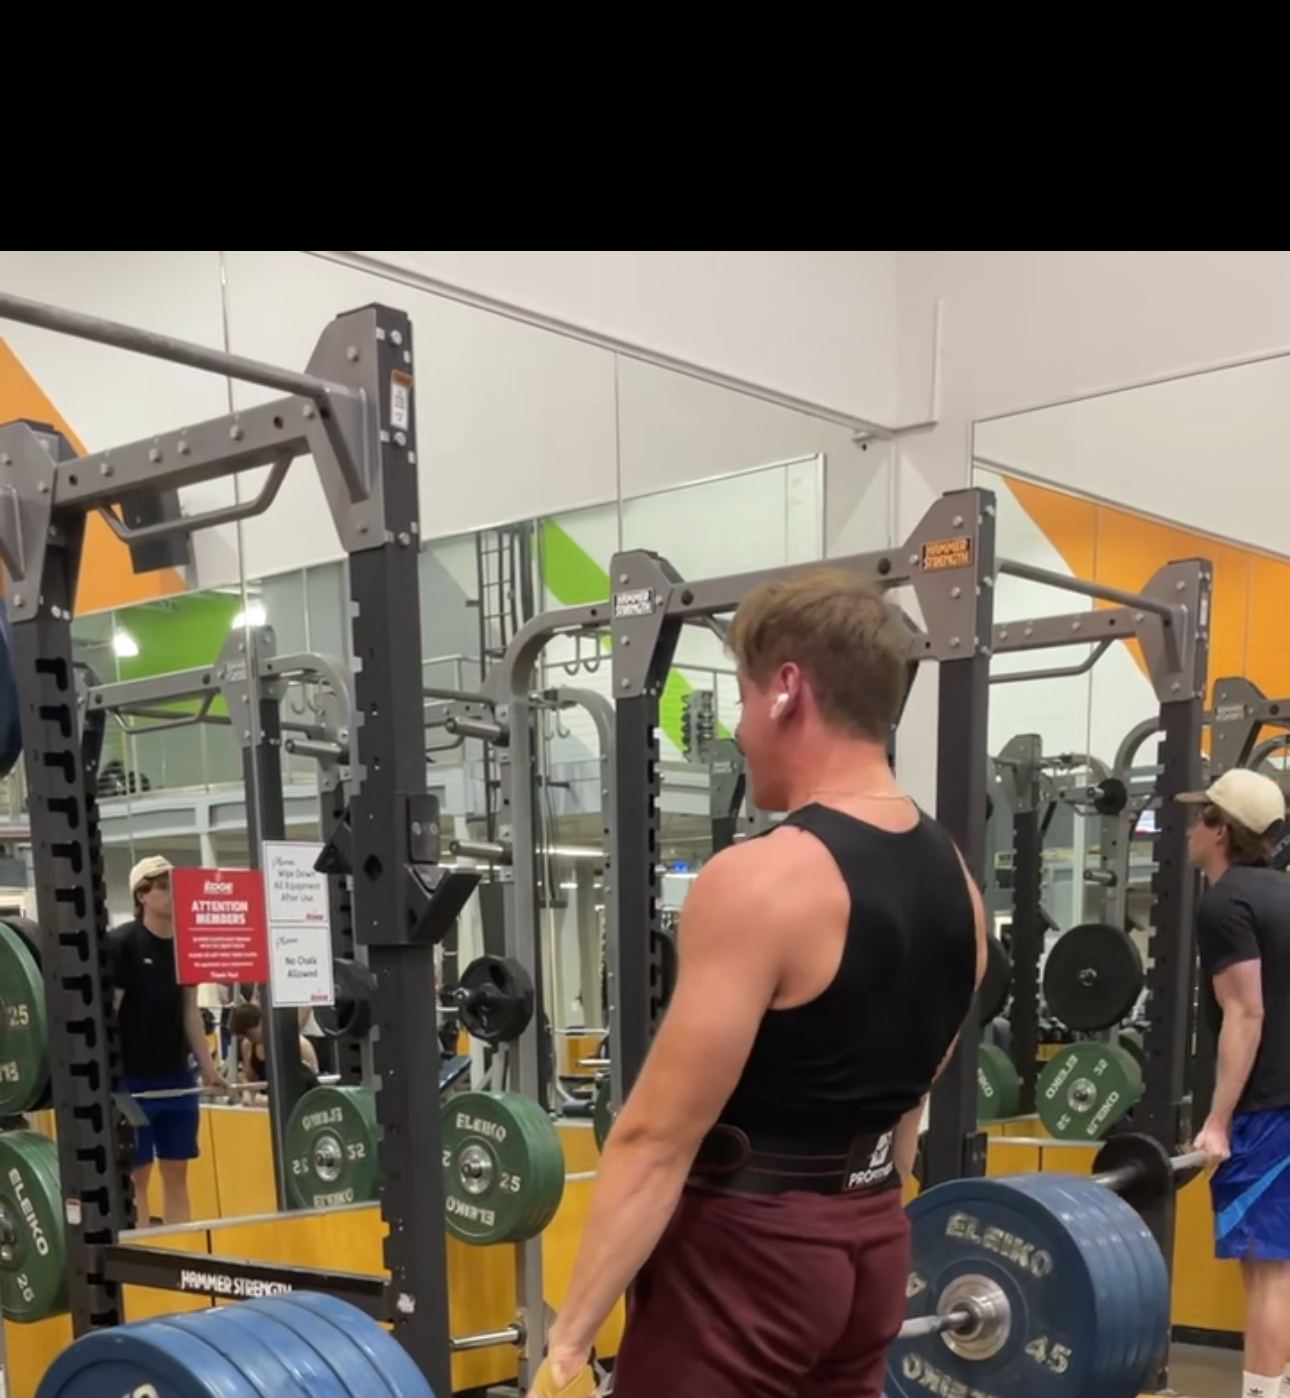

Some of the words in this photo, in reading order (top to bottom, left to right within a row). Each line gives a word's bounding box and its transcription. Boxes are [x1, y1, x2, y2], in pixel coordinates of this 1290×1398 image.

[926, 540, 968, 557] HAMMER
[924, 552, 969, 570] STRENGTH
[191, 900, 249, 913] ATTENTION
[195, 913, 247, 926] MEMBERS
[284, 956, 296, 966] No
[297, 955, 318, 967] Chalk
[287, 968, 318, 979] Allowed
[8, 1003, 30, 1027] 25
[456, 1112, 507, 1143] ELEIKO
[499, 1172, 522, 1193] 25
[8, 1167, 49, 1257] ELEIKO
[445, 1195, 496, 1227] ELEIKO
[945, 1210, 1053, 1278] ELEIKO
[180, 1269, 232, 1295] HAMMER
[1024, 1335, 1072, 1374] 45
